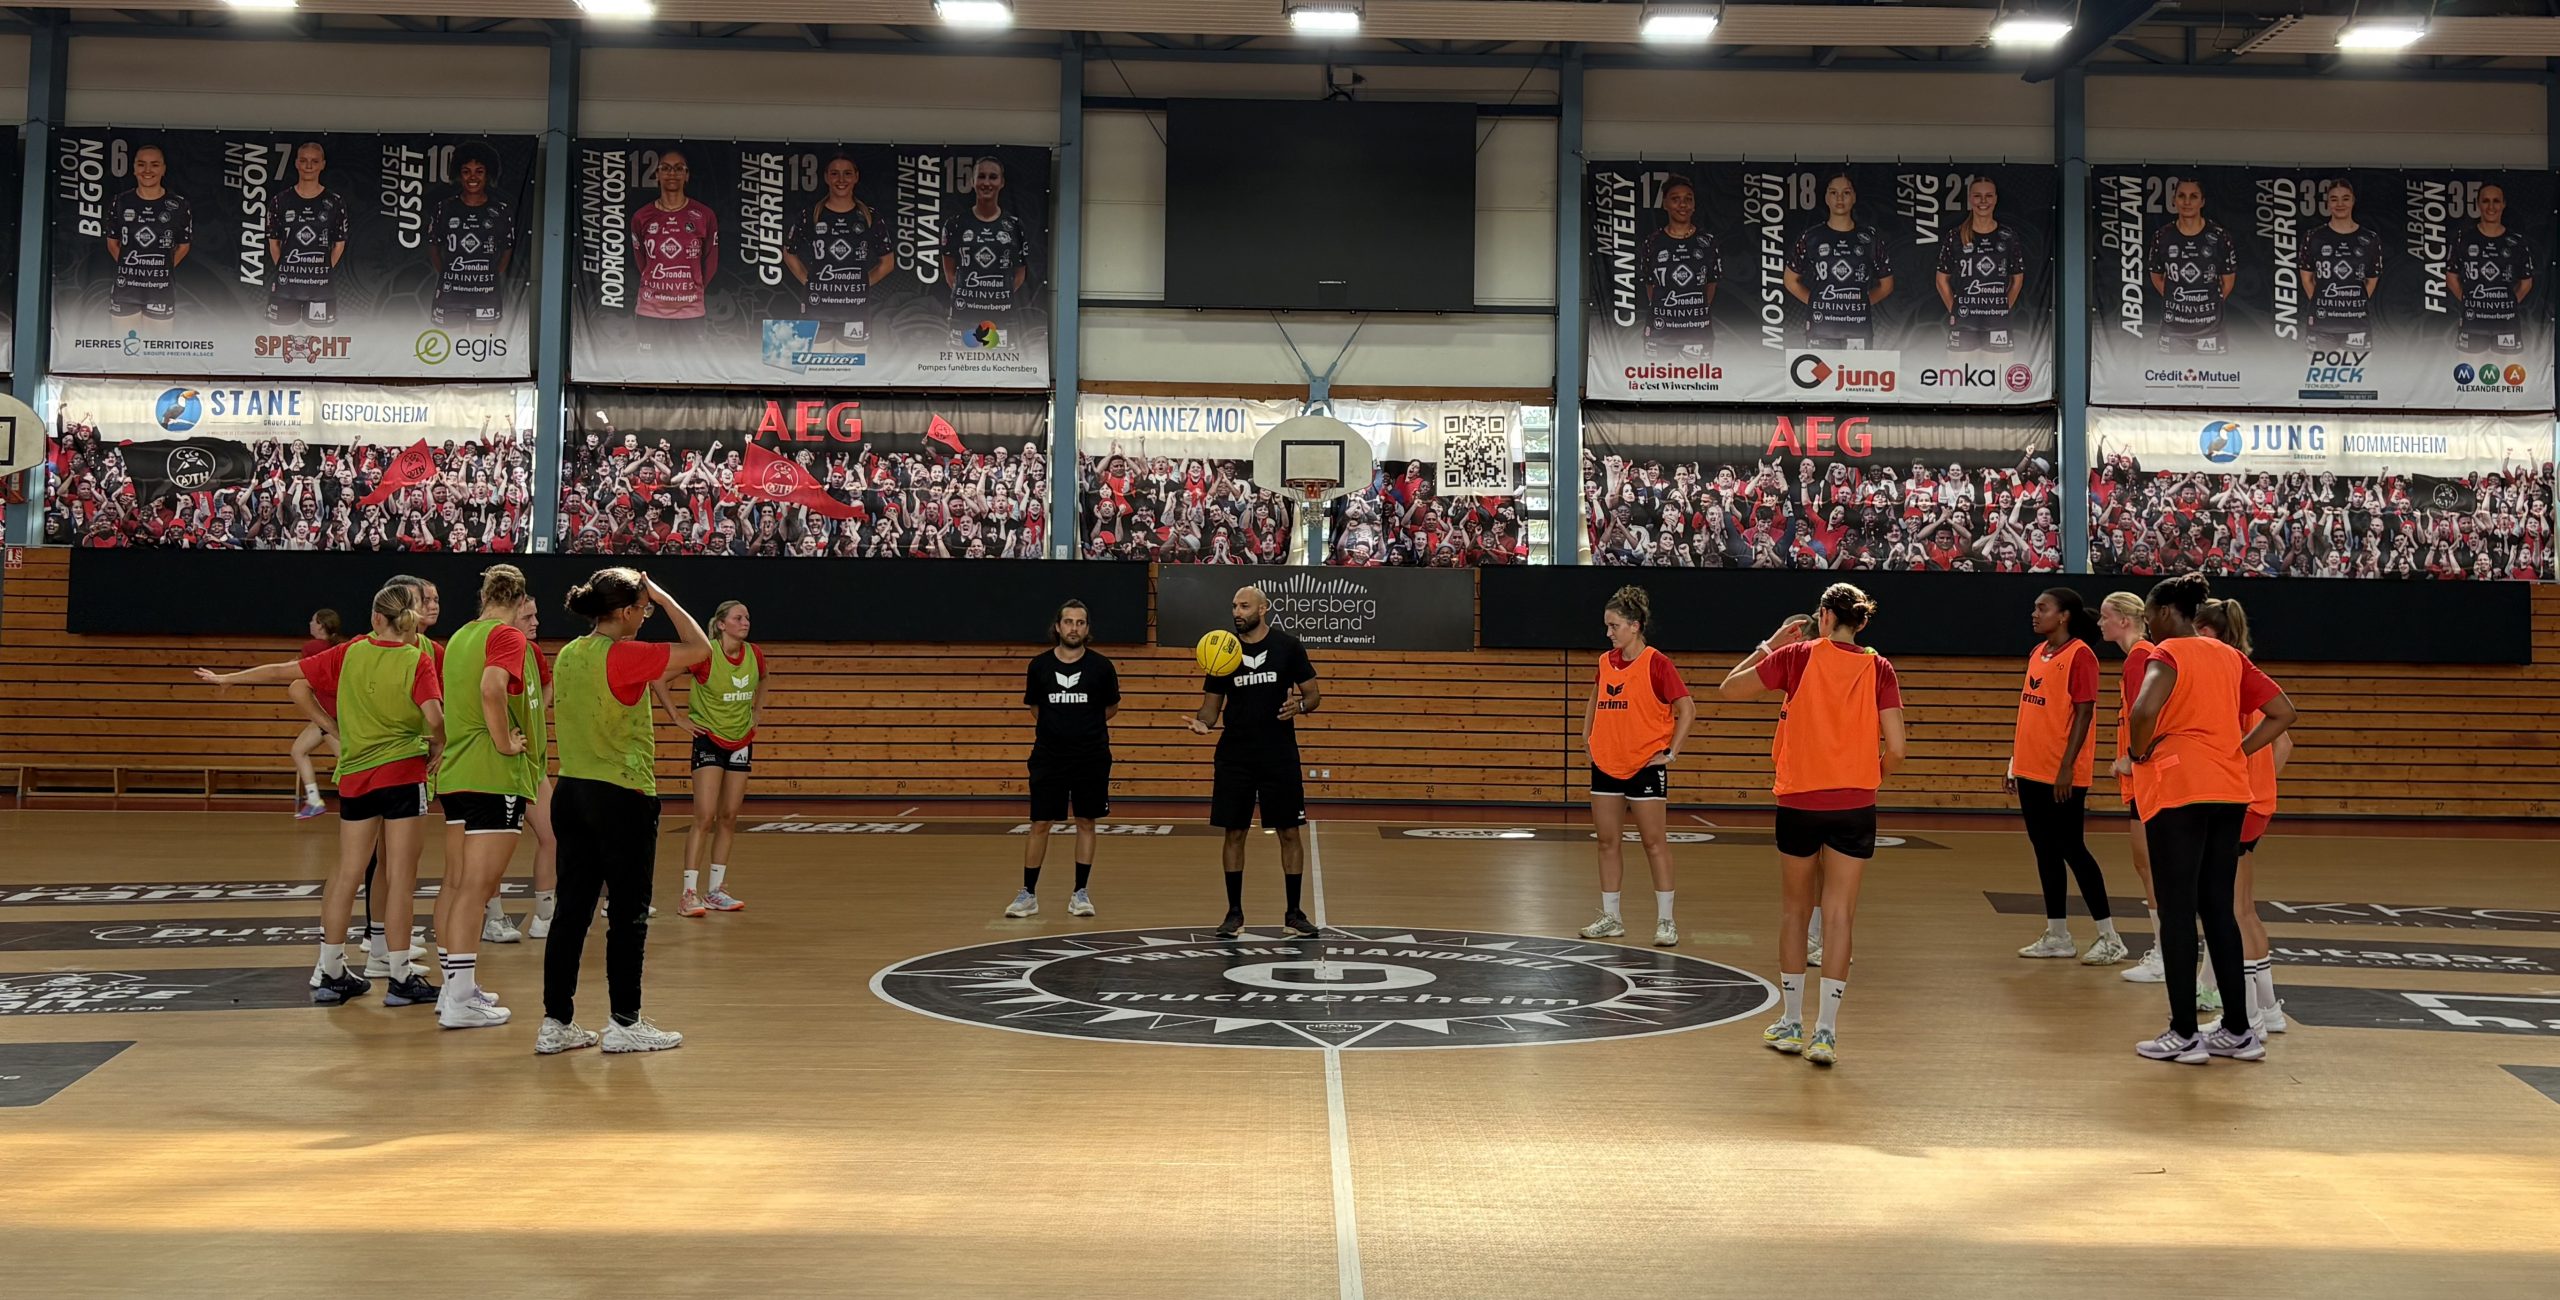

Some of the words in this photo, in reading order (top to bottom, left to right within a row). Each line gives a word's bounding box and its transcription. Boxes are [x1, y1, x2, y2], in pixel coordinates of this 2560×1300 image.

[60, 138, 79, 200] LILOU
[111, 139, 128, 178] 6
[224, 141, 244, 189] ELIN
[274, 143, 292, 181] 7
[427, 144, 456, 184] 10
[629, 150, 660, 188] 12
[788, 153, 819, 192] 13
[944, 156, 974, 194] 15
[78, 138, 104, 237] BEGON
[380, 144, 400, 217] LOUISE
[398, 145, 424, 249] CUSSET
[1640, 172, 1669, 208] 17
[1743, 173, 1761, 224] YOSR
[1787, 172, 1816, 210] 18
[1897, 174, 1915, 217] LISA
[1945, 173, 1975, 211] 21
[2300, 179, 2332, 217] 33
[2448, 180, 2483, 219] 35
[239, 143, 268, 286] KARLSSON
[582, 149, 601, 274] ELIHANNAH
[738, 152, 761, 264] CHARLÈNE
[759, 152, 784, 286] GUERRIER
[897, 155, 915, 270] CORENTINE
[917, 154, 941, 284] CAVALIER
[1594, 172, 1613, 256] MÉLISSA
[1916, 174, 1939, 244] VLUG
[2100, 175, 2120, 249] DALILA
[2255, 179, 2274, 238] NORA
[2406, 179, 2425, 261] ALBANE
[1613, 172, 1635, 326] CHANTELLY
[1761, 173, 1784, 350] MOSTEFAOUI
[2120, 175, 2143, 338] ABDESSELAM
[2274, 178, 2298, 341] SNEDKERUD
[2424, 180, 2447, 313] FRACHON
[809, 282, 866, 292] EURINVEST
[1654, 307, 1709, 317] EURINVEST
[1812, 302, 1866, 311] EURINVEST
[75, 339, 121, 349] PIERRES
[143, 340, 214, 350] TERRITOIRES
[455, 333, 507, 362] egis
[798, 353, 859, 364] Univer
[956, 352, 1020, 361] WEIDMANN
[2310, 351, 2369, 366] POLY
[918, 363, 947, 372] Pompes
[948, 363, 980, 371] funèbres
[993, 364, 1038, 374] Kochersberg
[1624, 363, 1723, 379] cuisinella
[1661, 381, 1719, 391] Wiwersheim
[1835, 364, 1896, 392] jung
[1921, 363, 1996, 387] emka
[2145, 369, 2183, 381] Crédit
[2199, 371, 2240, 382] Mutuel
[2306, 367, 2365, 383] RACK
[210, 389, 302, 416] STANE
[2457, 385, 2501, 393] ALEXANDRE
[321, 402, 429, 423] GEISPOLSHEIM
[754, 400, 863, 442] AEG
[1104, 406, 1200, 433] SCANNEZ
[1205, 407, 1246, 433] MOI
[1766, 415, 1872, 458] AEG
[2251, 424, 2326, 451] JUNG
[2343, 434, 2447, 454] MOMMENHEIM
[1265, 594, 1376, 620] ochersberg
[1270, 613, 1362, 632] Ackerland
[1297, 635, 1332, 644] lument
[1334, 635, 1376, 644] d'avenir!
[723, 690, 753, 702] erima
[1048, 690, 1088, 704] erima
[1234, 671, 1277, 688] erima
[1597, 698, 1628, 710] erima
[1095, 946, 1302, 964] PIRATHS
[1326, 947, 1574, 971] HANDBALL
[2269, 947, 2538, 965] utagaz
[1096, 991, 1579, 1005] Truchtersheim
